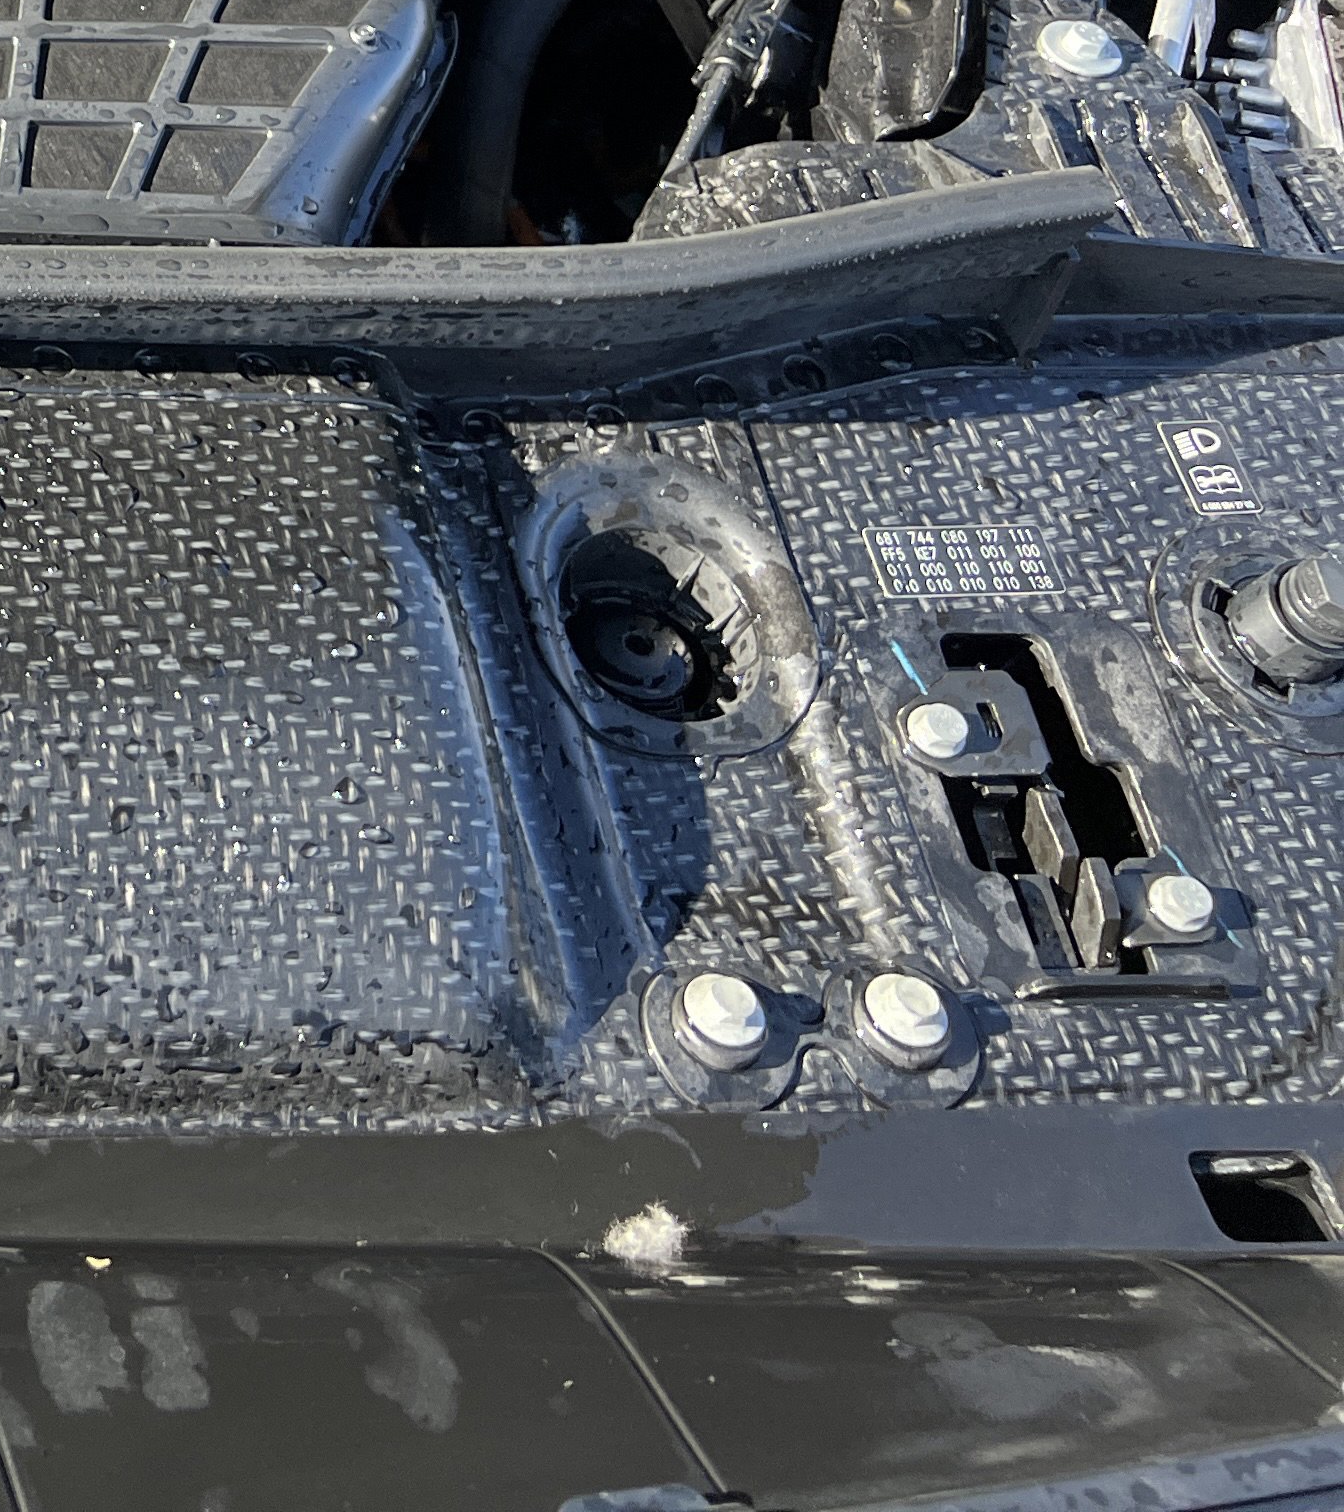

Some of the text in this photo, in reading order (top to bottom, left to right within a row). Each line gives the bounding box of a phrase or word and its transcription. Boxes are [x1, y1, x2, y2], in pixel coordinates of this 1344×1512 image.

[875, 529, 1033, 545] 681 744 080 197 111
[881, 544, 1040, 561] FF5 KE7 011 001 100
[887, 560, 1046, 577] 011 000 110 110 001
[926, 578, 952, 591] 010
[960, 577, 986, 591] 010
[993, 576, 1019, 590] 010
[1028, 576, 1054, 589] 138
